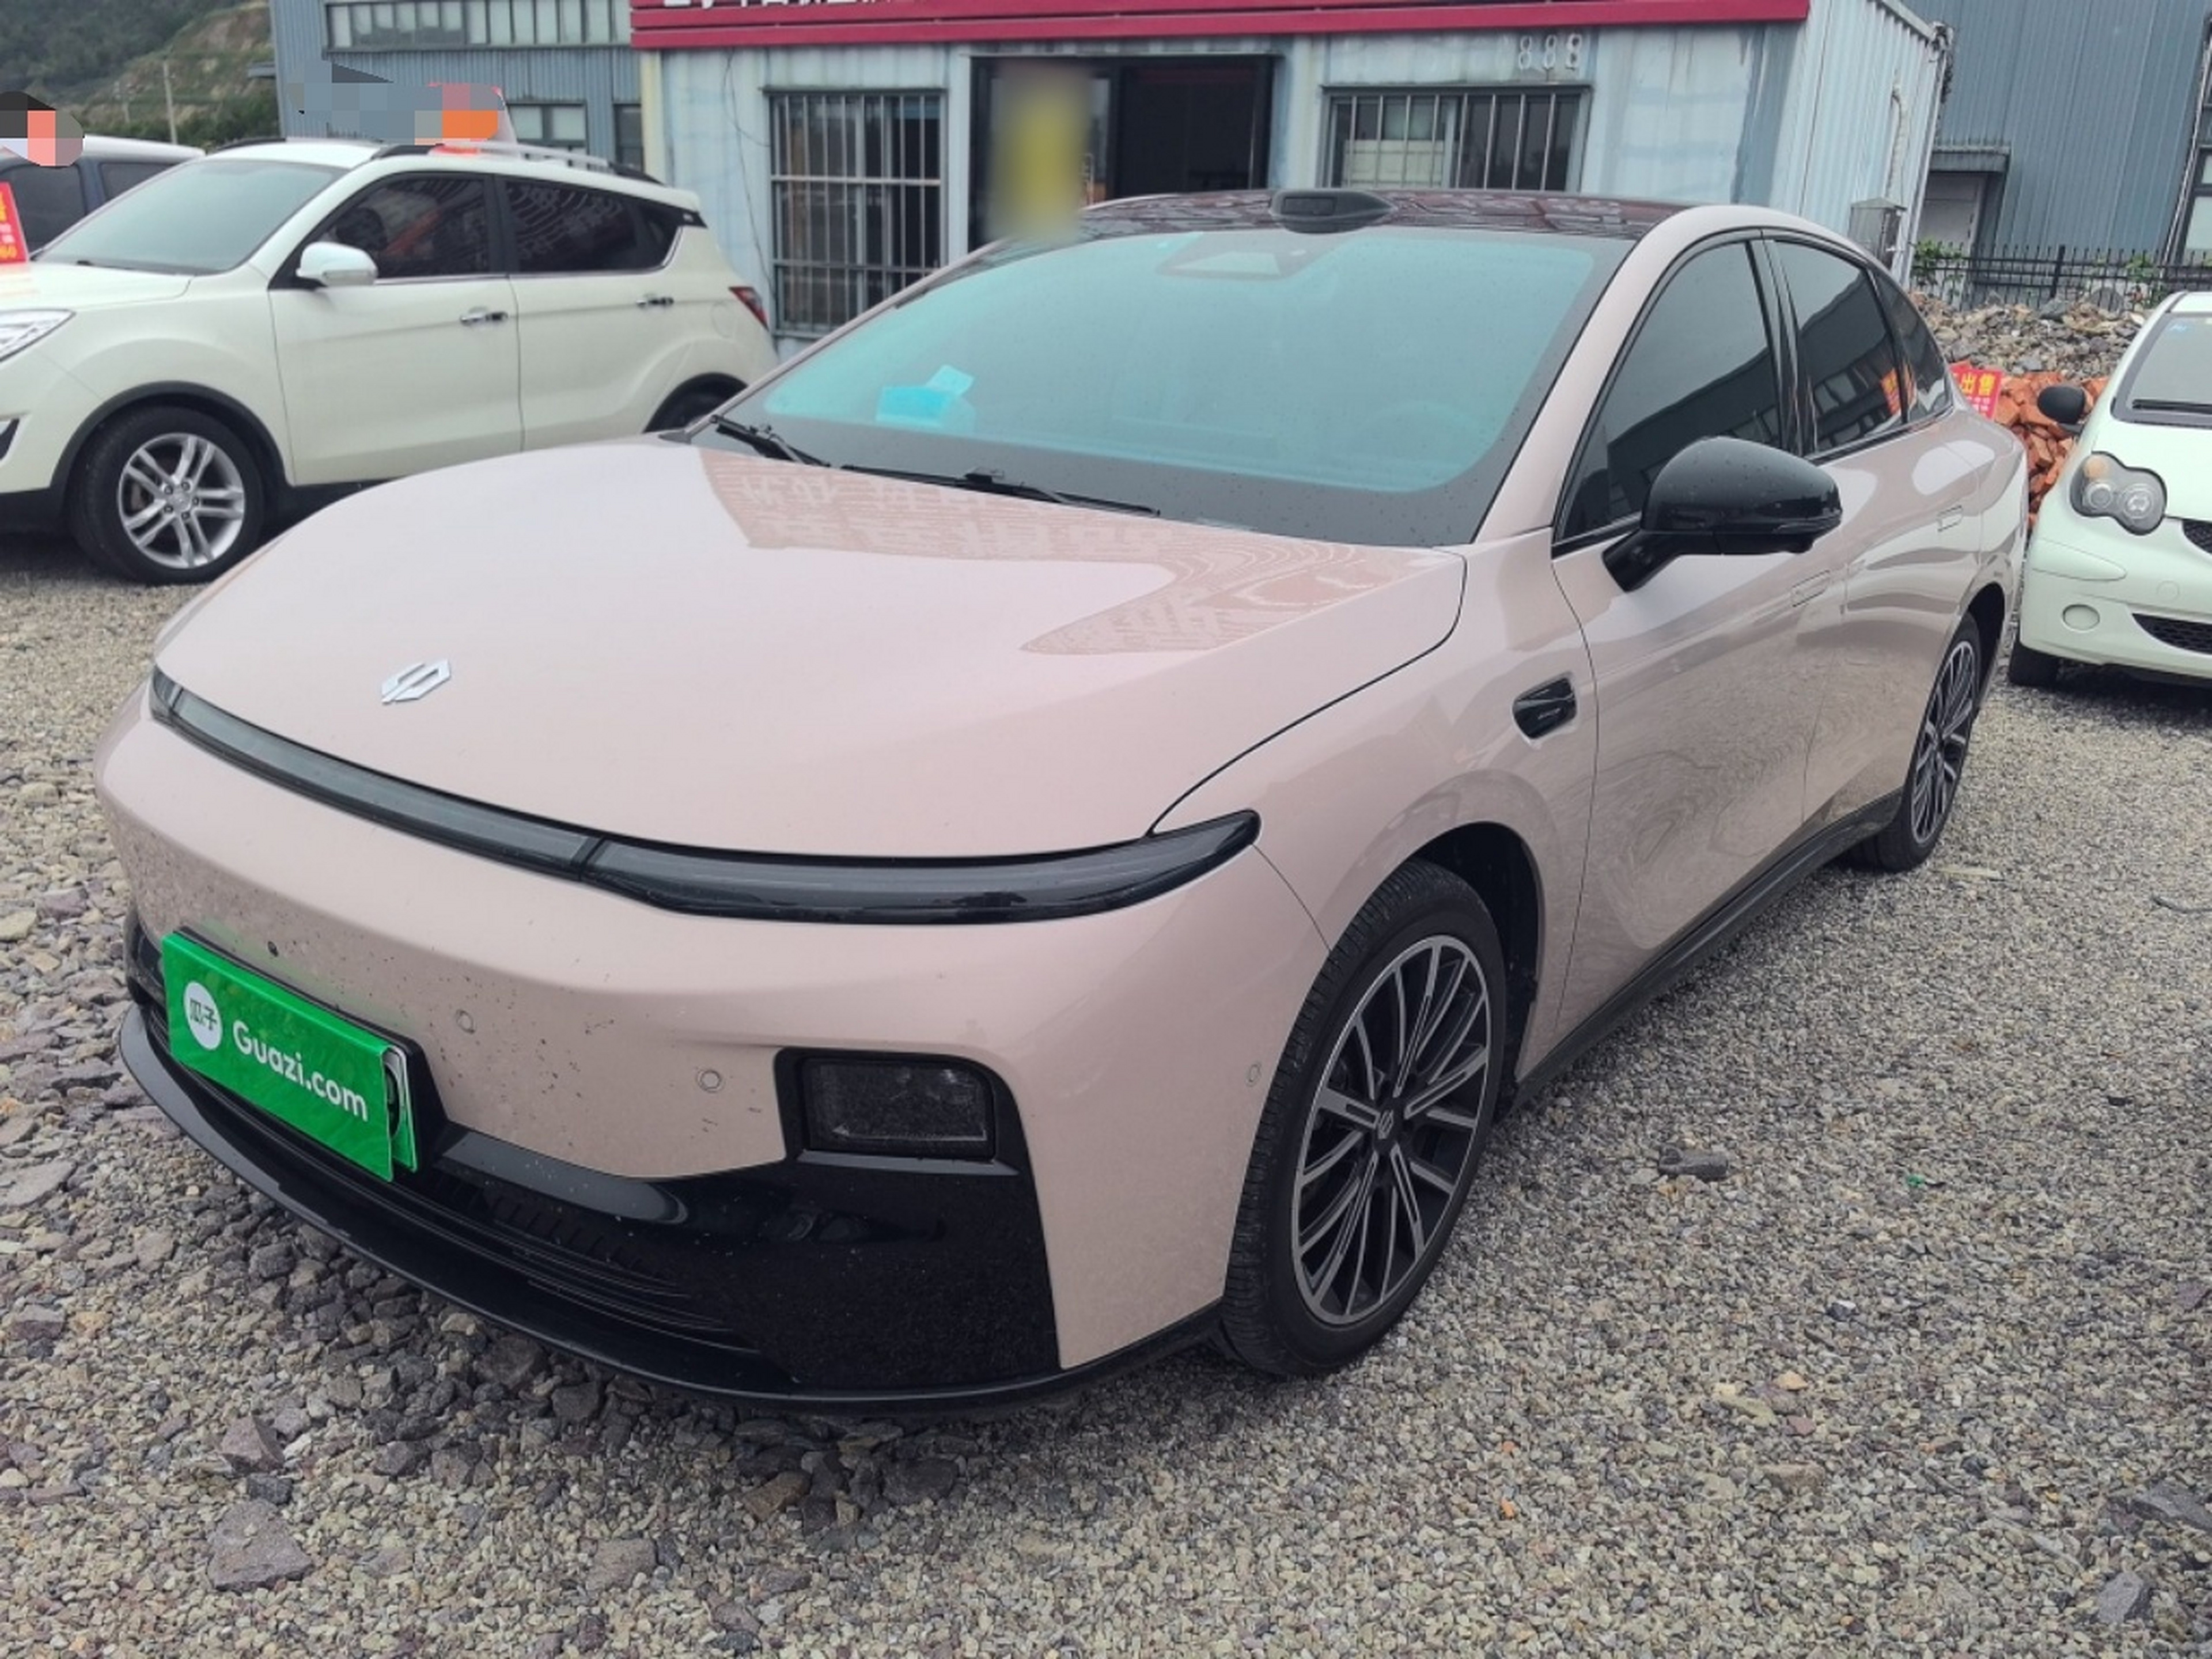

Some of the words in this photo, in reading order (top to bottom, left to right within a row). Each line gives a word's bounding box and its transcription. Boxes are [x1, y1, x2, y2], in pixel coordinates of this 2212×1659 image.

[1518, 33, 1582, 70] 888
[1953, 372, 1995, 396] 出售
[190, 998, 217, 1031] 瓜子
[233, 1020, 368, 1122] Guazi.com
